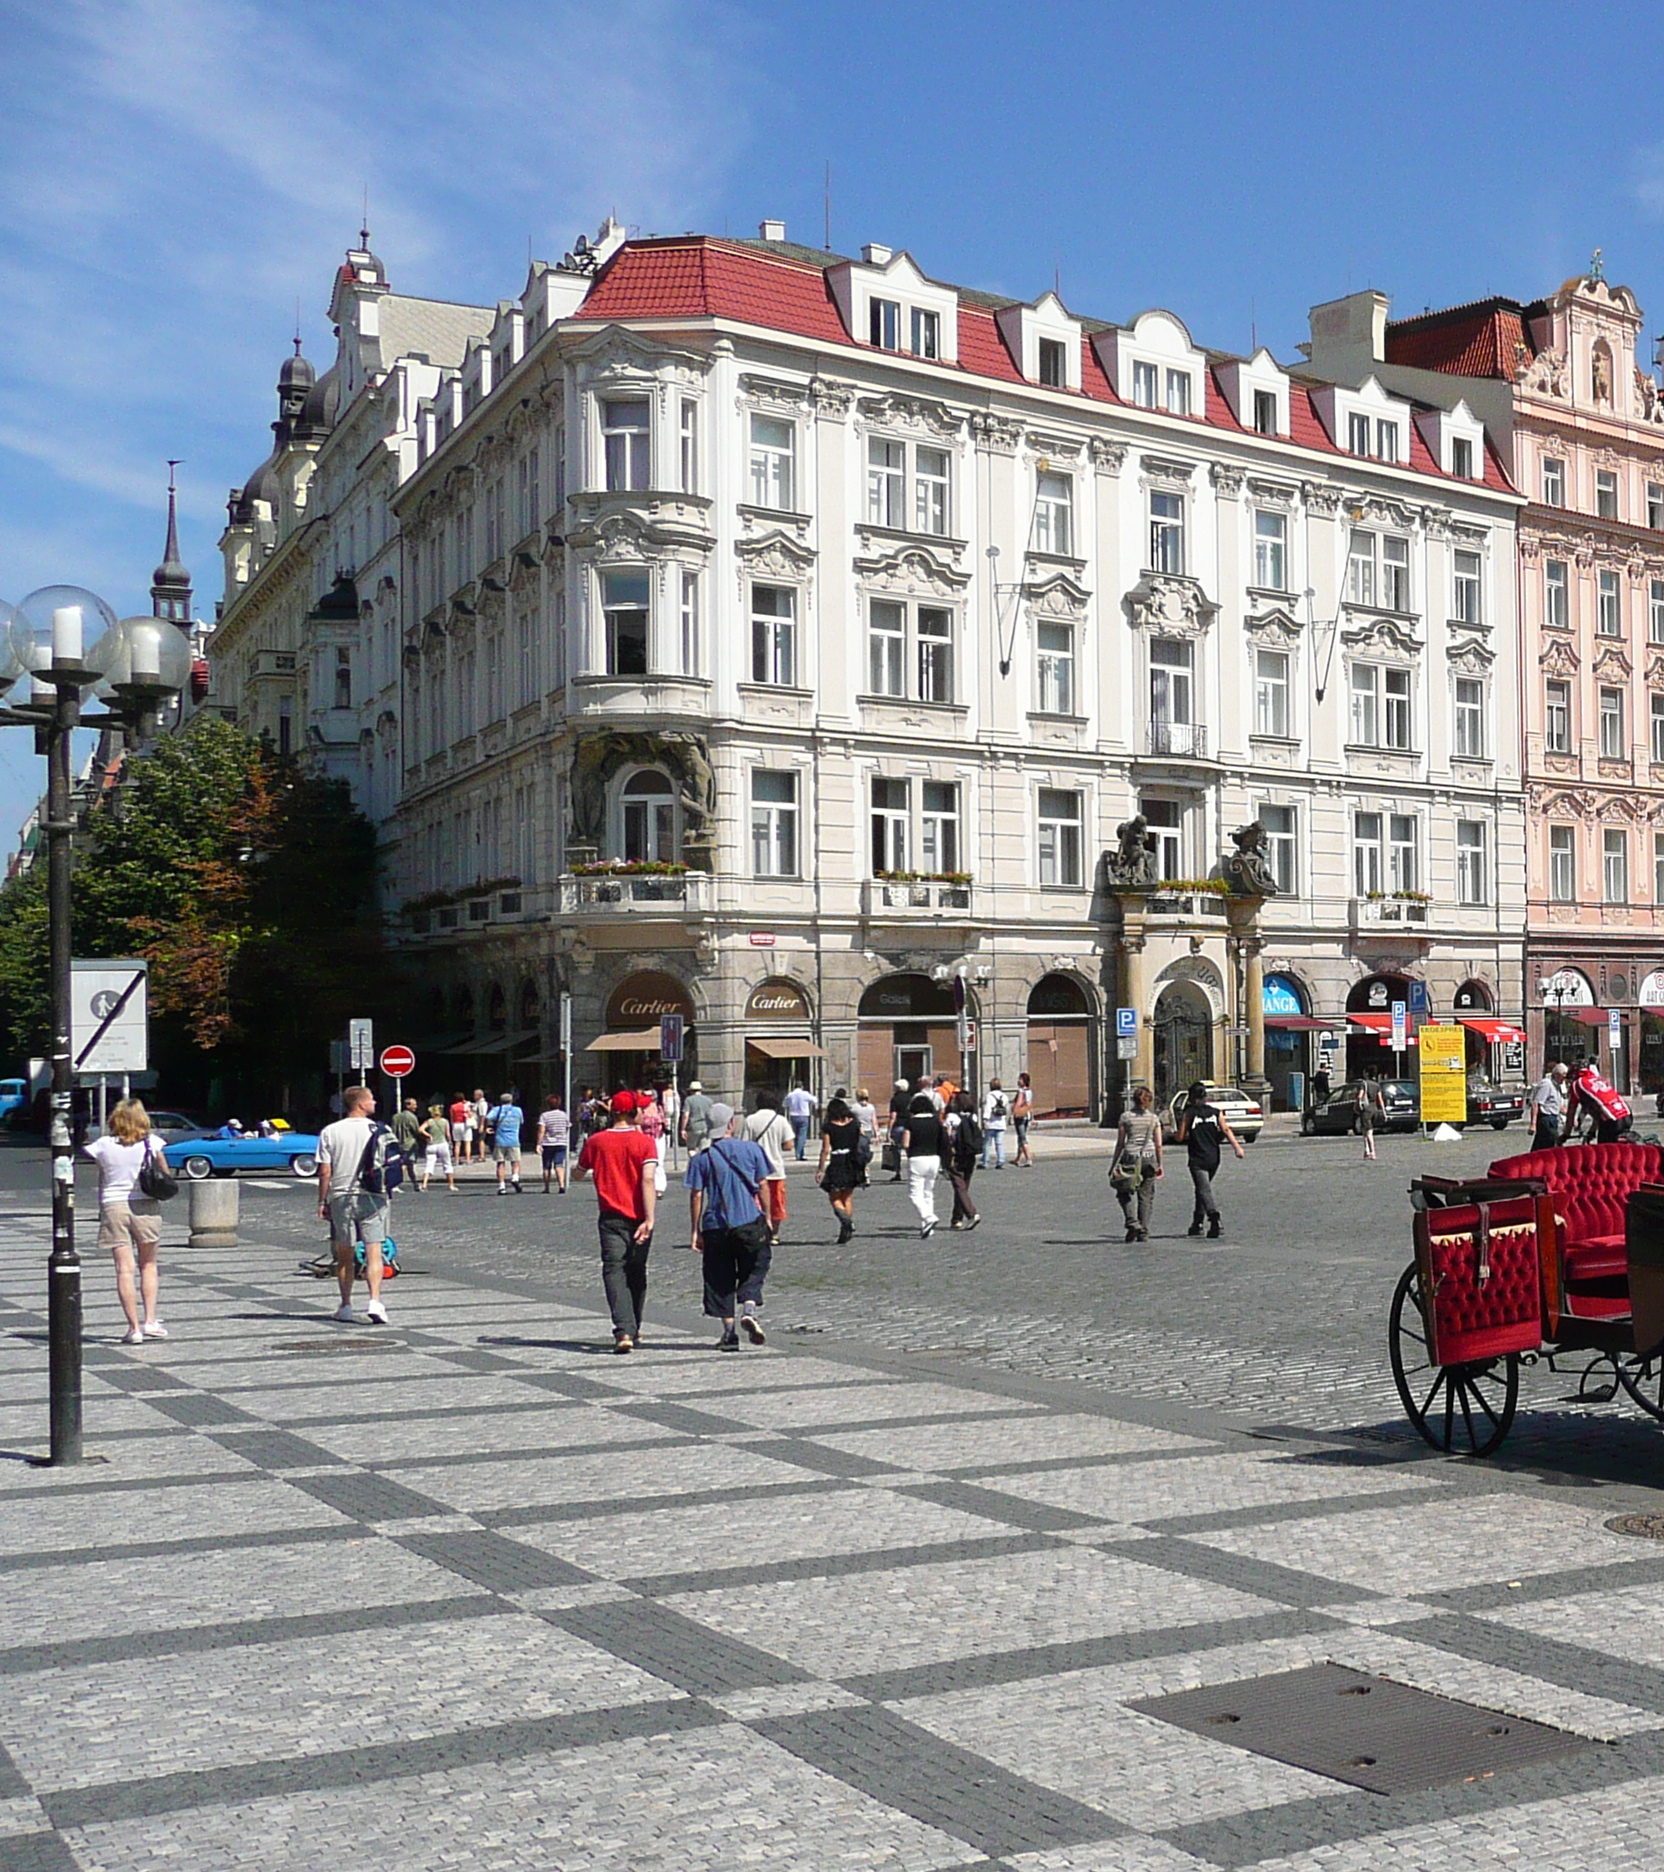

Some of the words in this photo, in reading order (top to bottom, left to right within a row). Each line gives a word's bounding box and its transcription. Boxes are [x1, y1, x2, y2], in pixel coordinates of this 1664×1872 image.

[751, 994, 801, 1009] Cartier
[1413, 985, 1422, 1003] P
[1646, 990, 1658, 1003] ART
[620, 997, 682, 1015] Cartier
[1396, 1005, 1404, 1018] P
[1121, 1012, 1134, 1027] P
[1612, 1014, 1618, 1023] P
